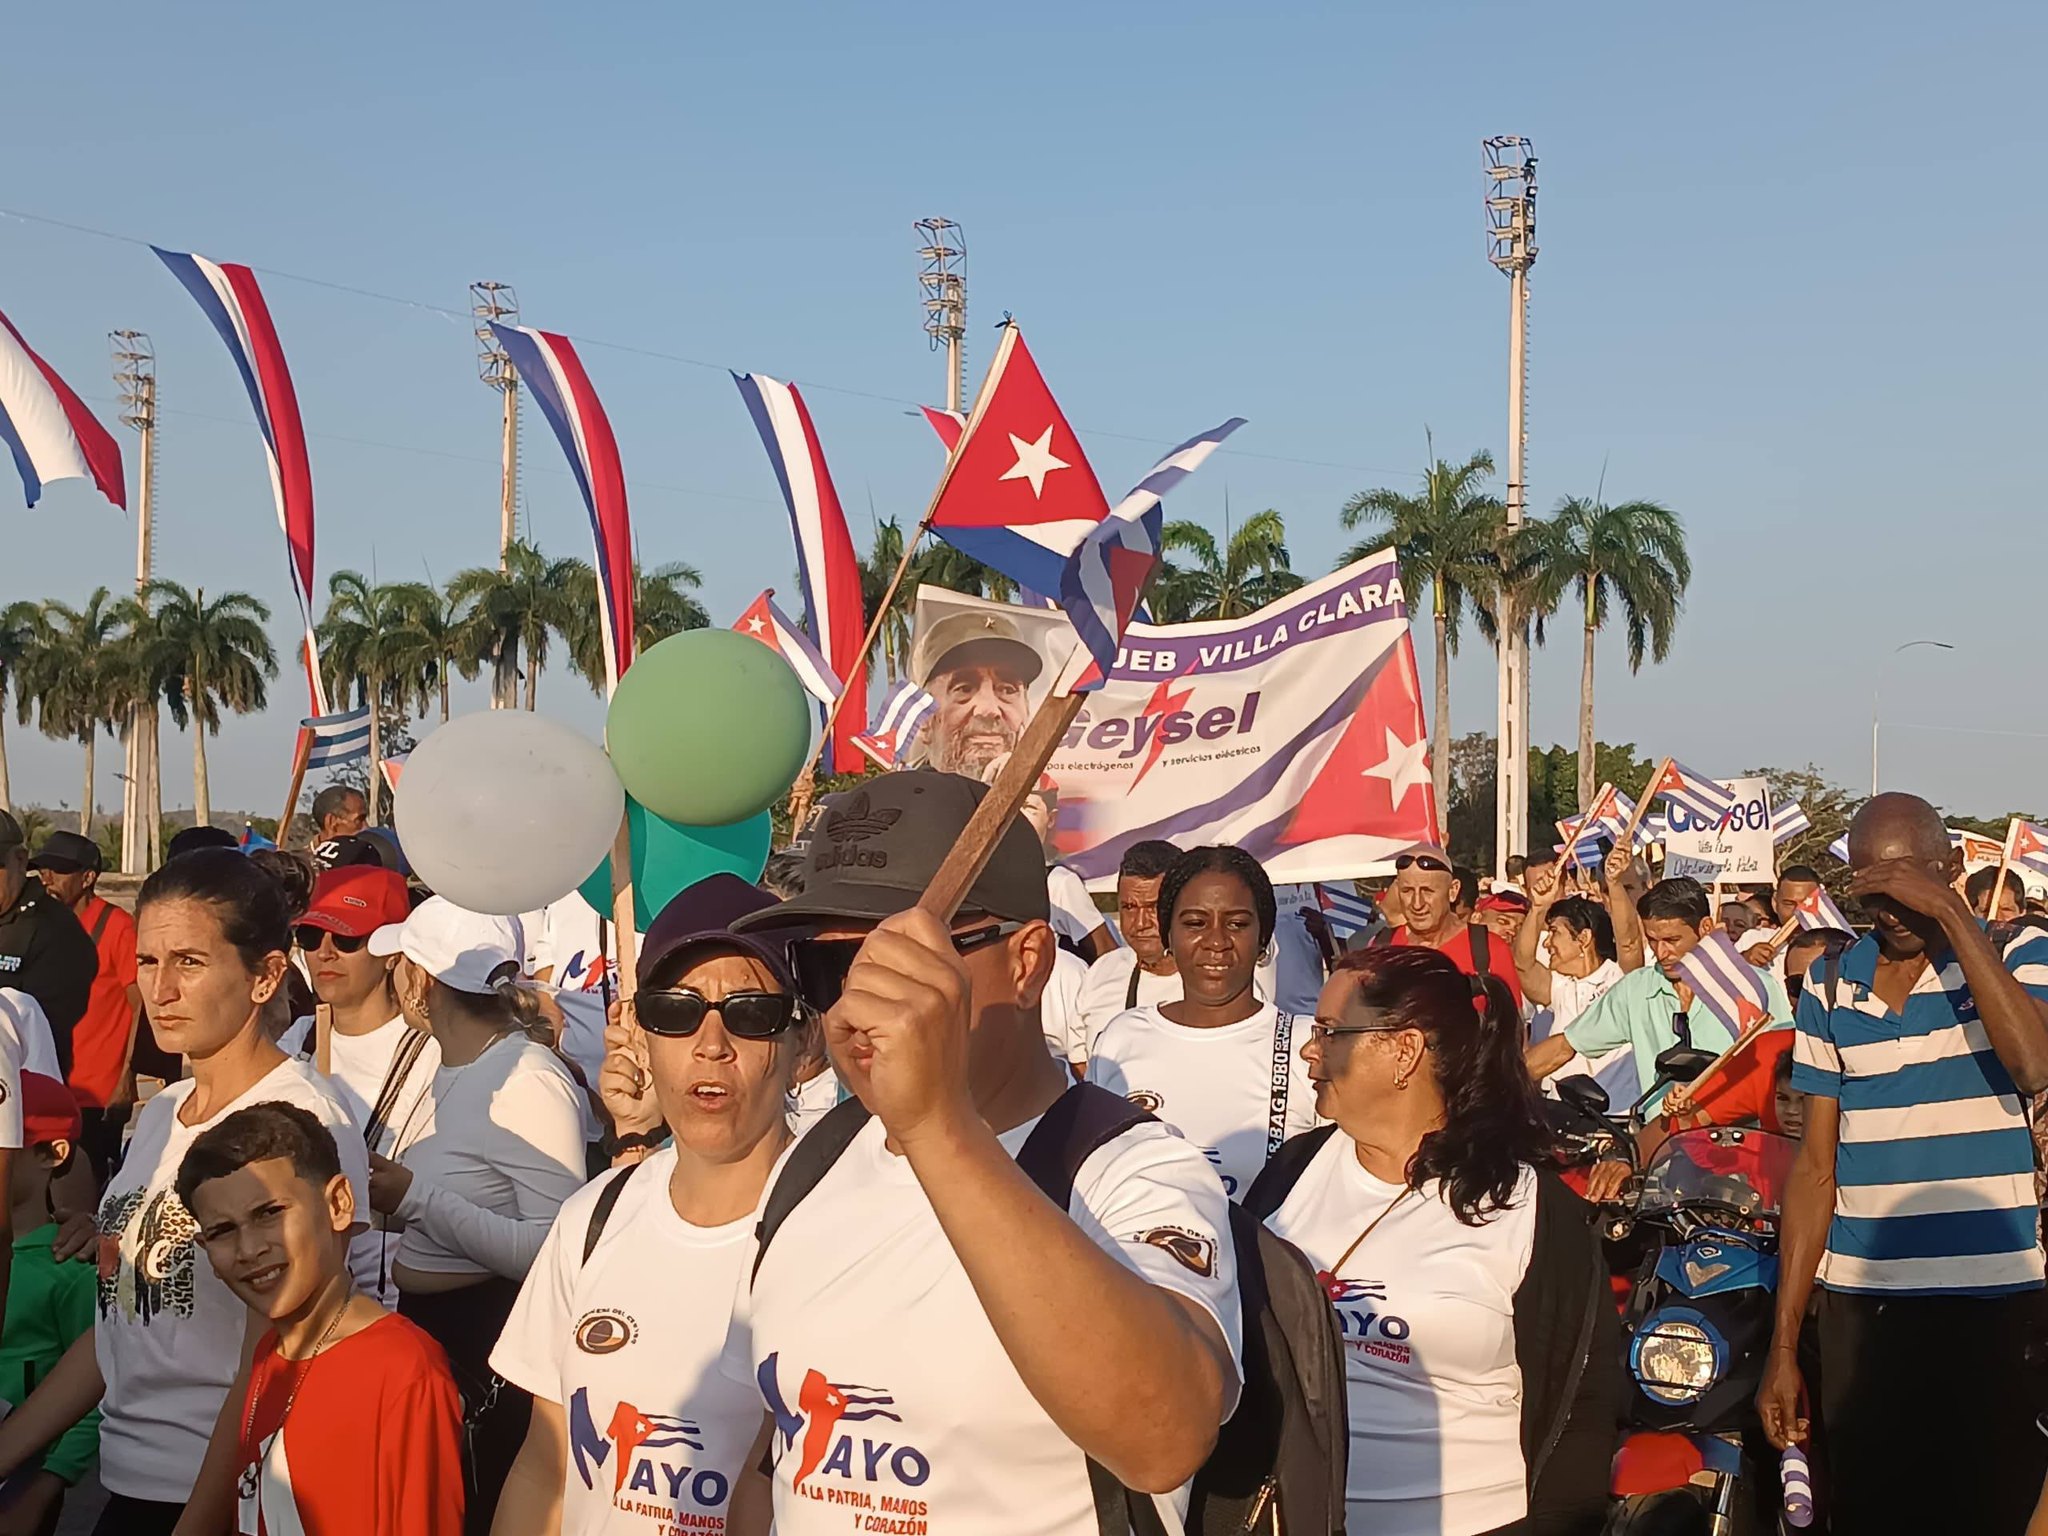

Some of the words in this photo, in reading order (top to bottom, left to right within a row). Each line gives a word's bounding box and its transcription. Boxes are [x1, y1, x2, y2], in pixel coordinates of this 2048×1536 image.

[1199, 624, 1288, 668] VILLA
[1298, 578, 1405, 632] CLARA
[620, 1498, 633, 1512] LA
[679, 1512, 725, 1530] MANOS
[801, 1483, 807, 1497] A
[810, 1485, 824, 1500] LA
[827, 1488, 876, 1512] PATRIA,
[880, 1496, 928, 1516] MANOS
[658, 1524, 665, 1535] Y
[855, 1513, 862, 1528] Y
[865, 1516, 927, 1535] CORAZÓN
